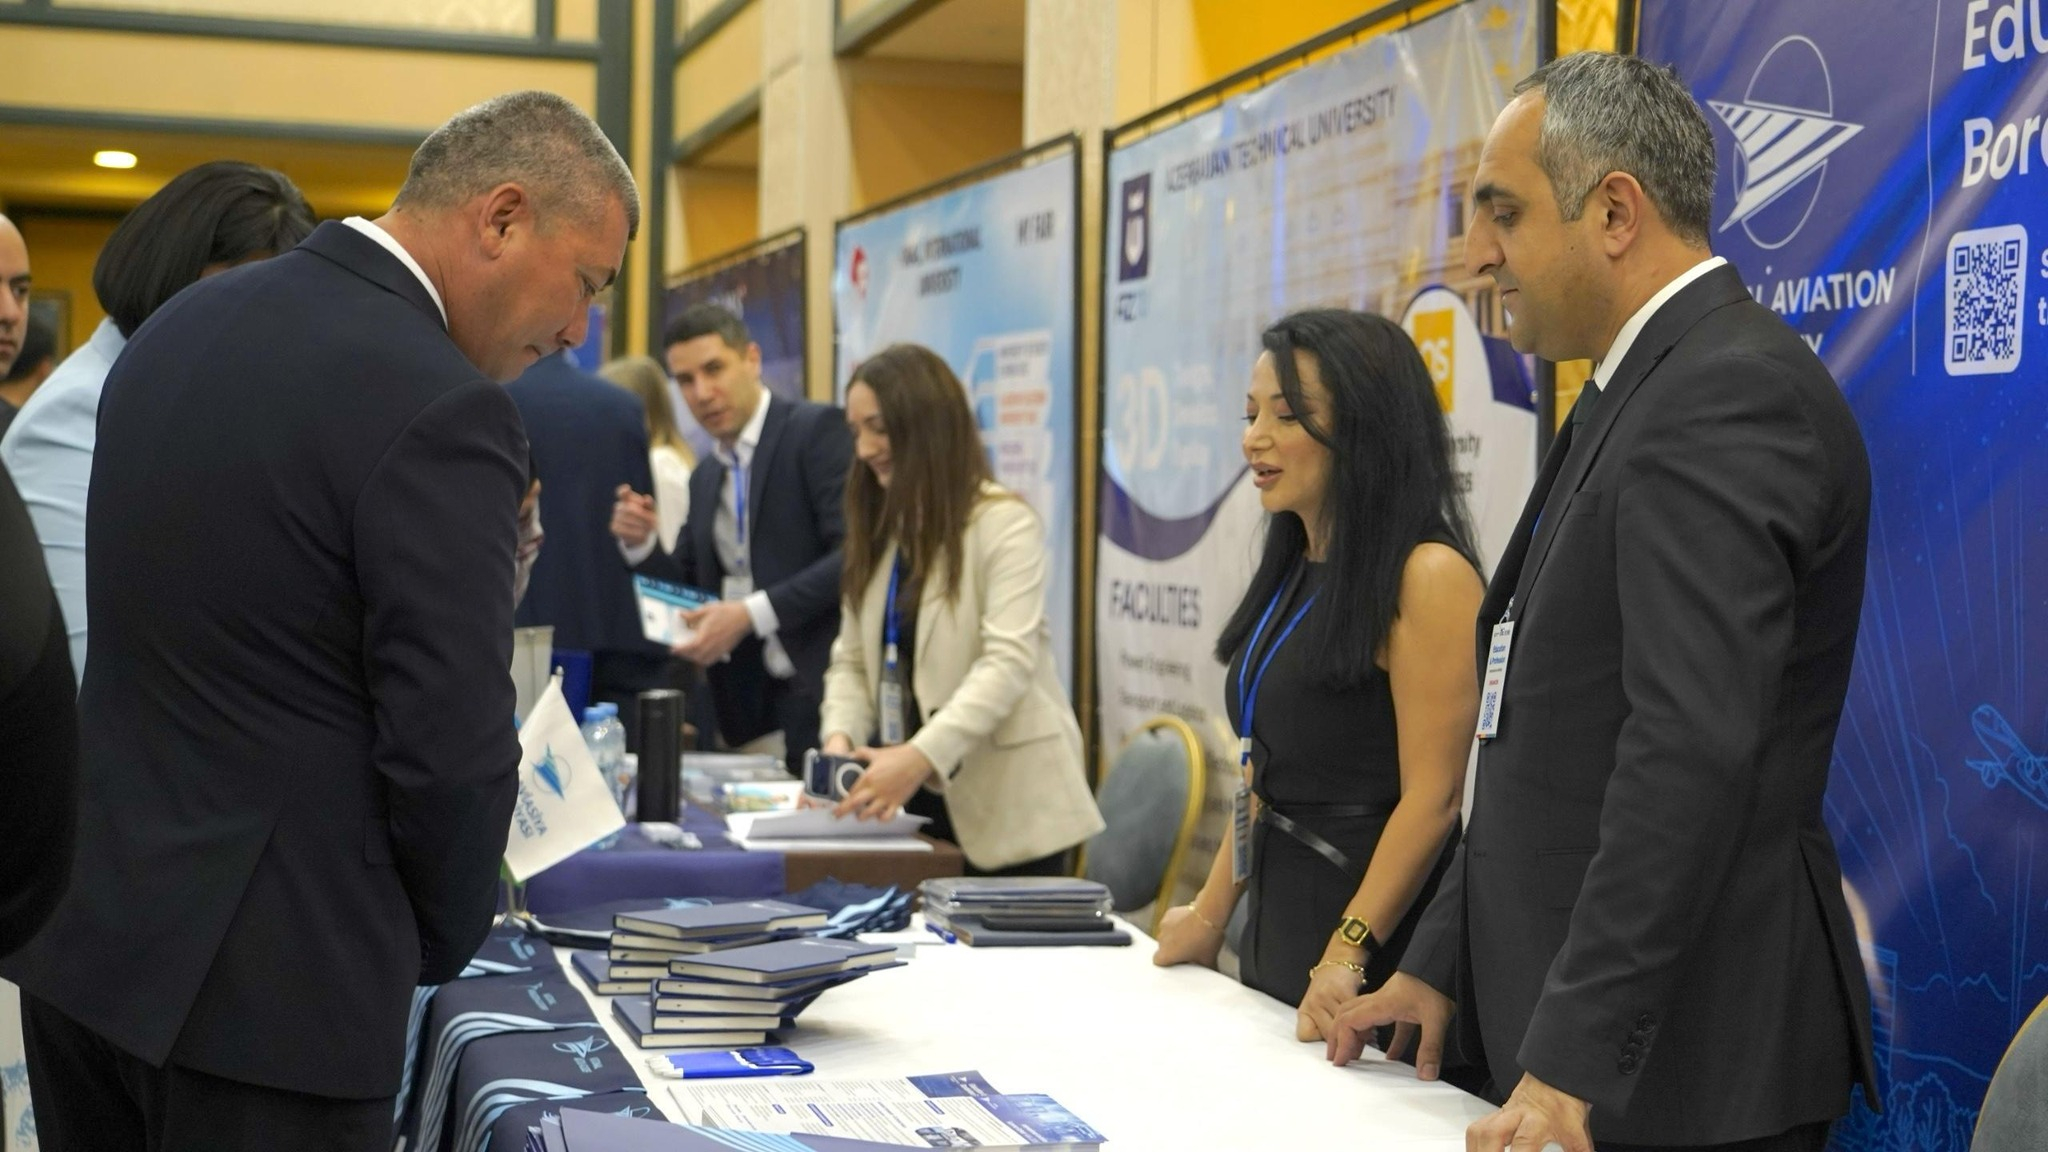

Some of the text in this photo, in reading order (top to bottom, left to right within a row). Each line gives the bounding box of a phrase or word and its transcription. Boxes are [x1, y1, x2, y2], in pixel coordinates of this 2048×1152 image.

[1234, 120, 1305, 169] TECHNICAL
[1307, 84, 1397, 146] UNIVERSITY
[1961, 115, 2048, 188] Bor
[1770, 267, 1896, 315] AVIATION
[1116, 365, 1169, 474] 3D
[1109, 578, 1201, 629] FACULTIES
